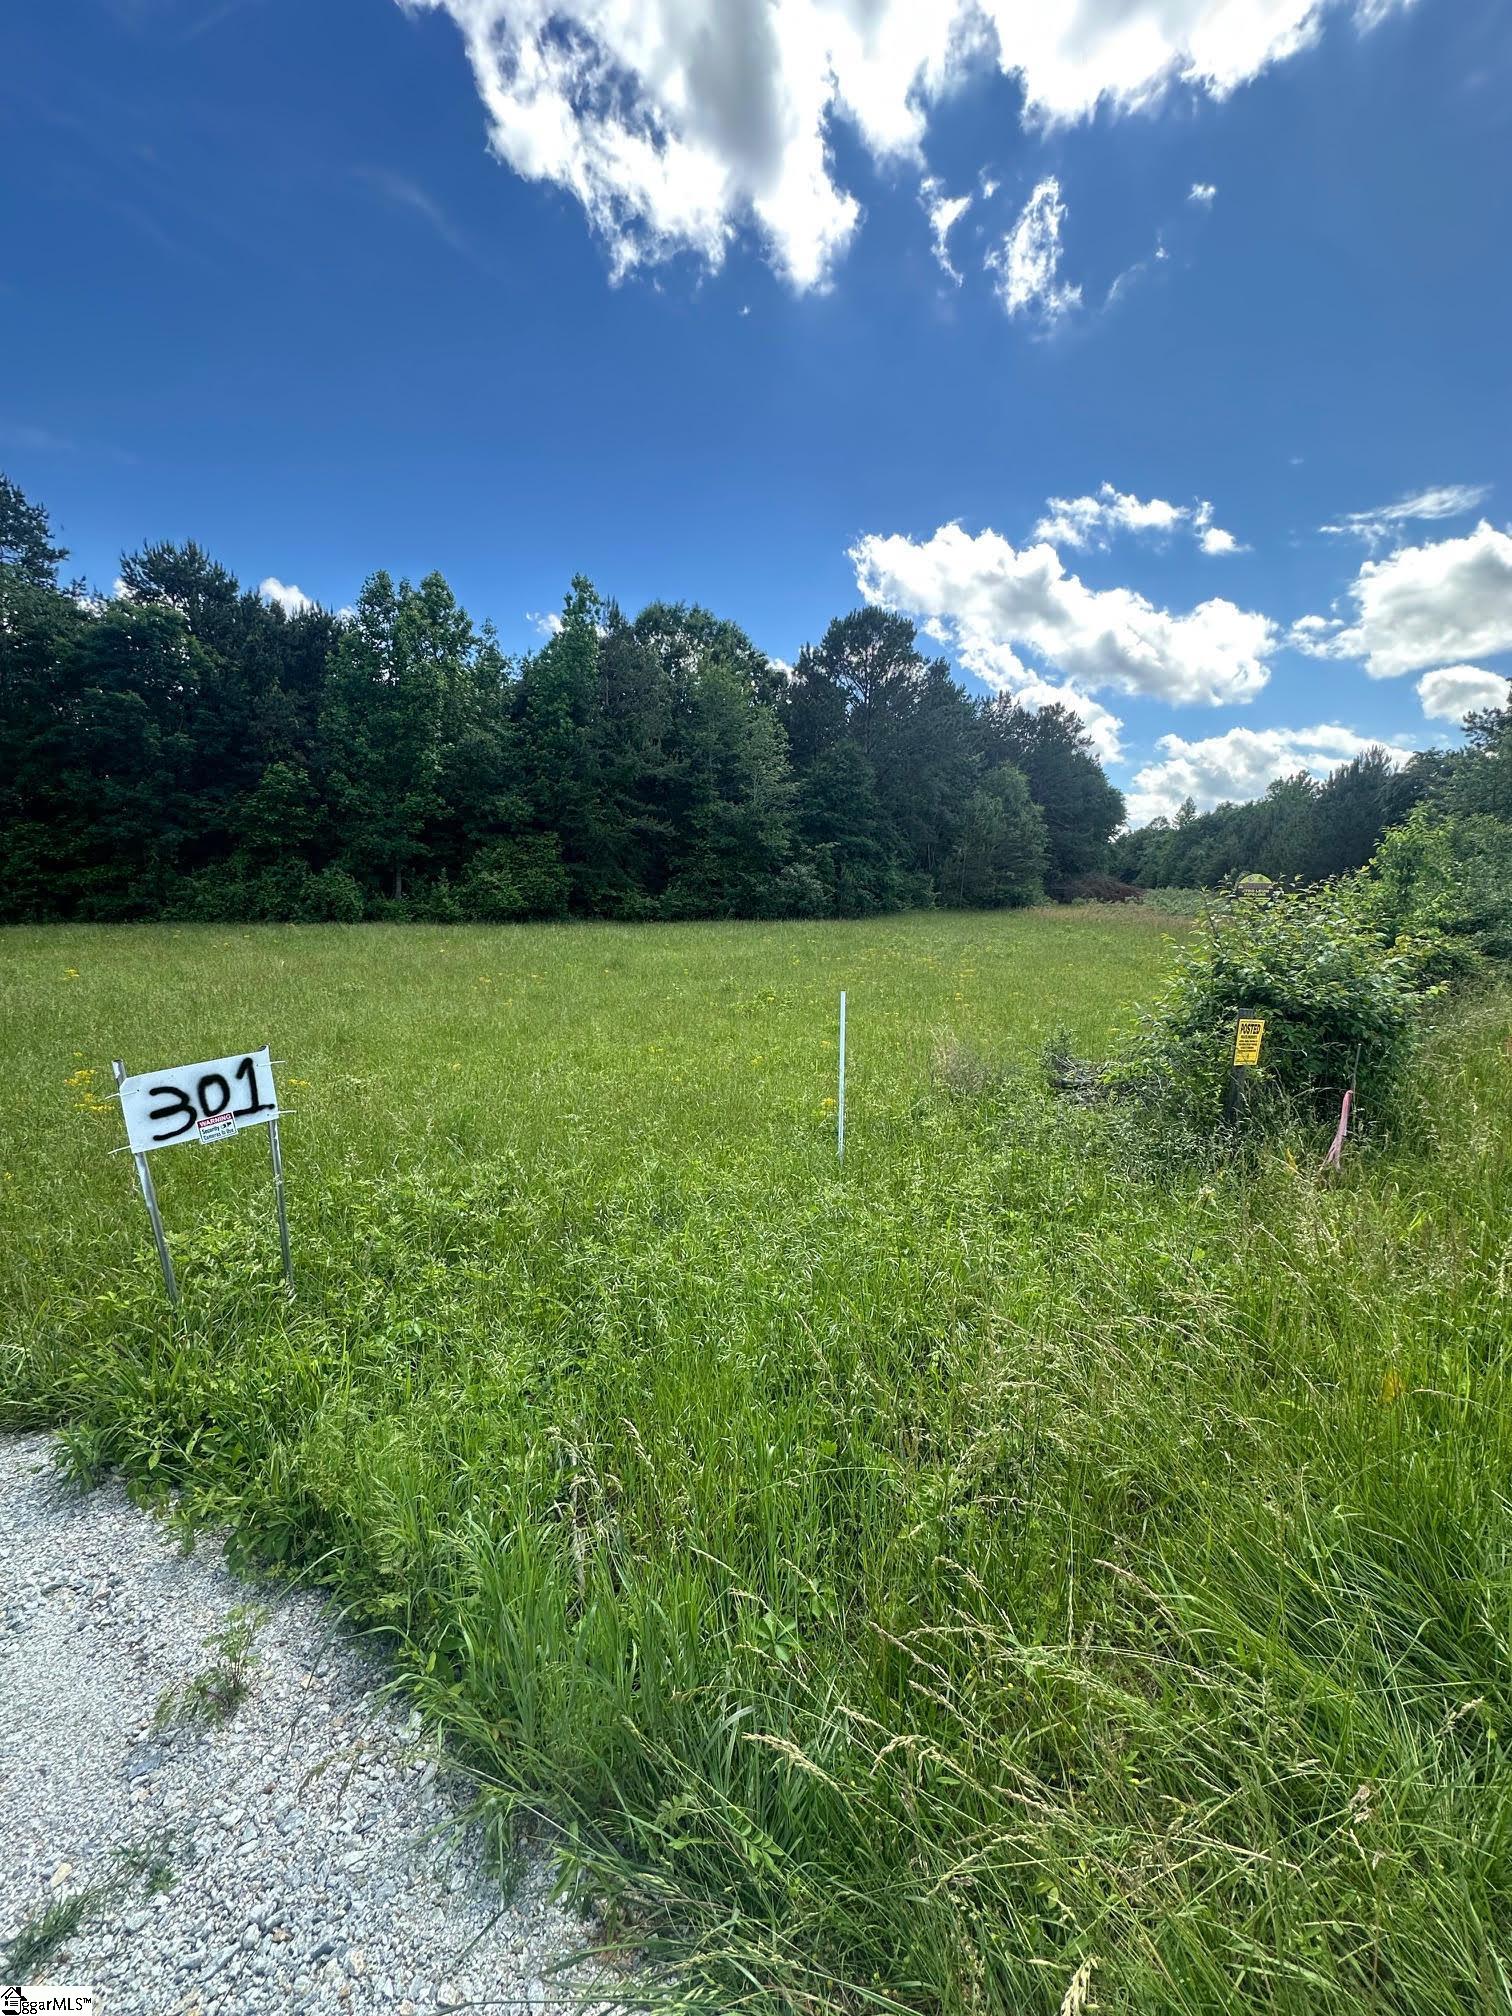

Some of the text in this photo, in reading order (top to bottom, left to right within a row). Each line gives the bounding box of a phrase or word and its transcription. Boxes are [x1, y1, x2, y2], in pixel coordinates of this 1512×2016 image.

[1240, 1023, 1260, 1034] POSTED
[149, 1057, 275, 1141] 301
[199, 1114, 231, 1127] WARNING
[202, 1126, 220, 1134] Security
[203, 1132, 221, 1140] Cameras
